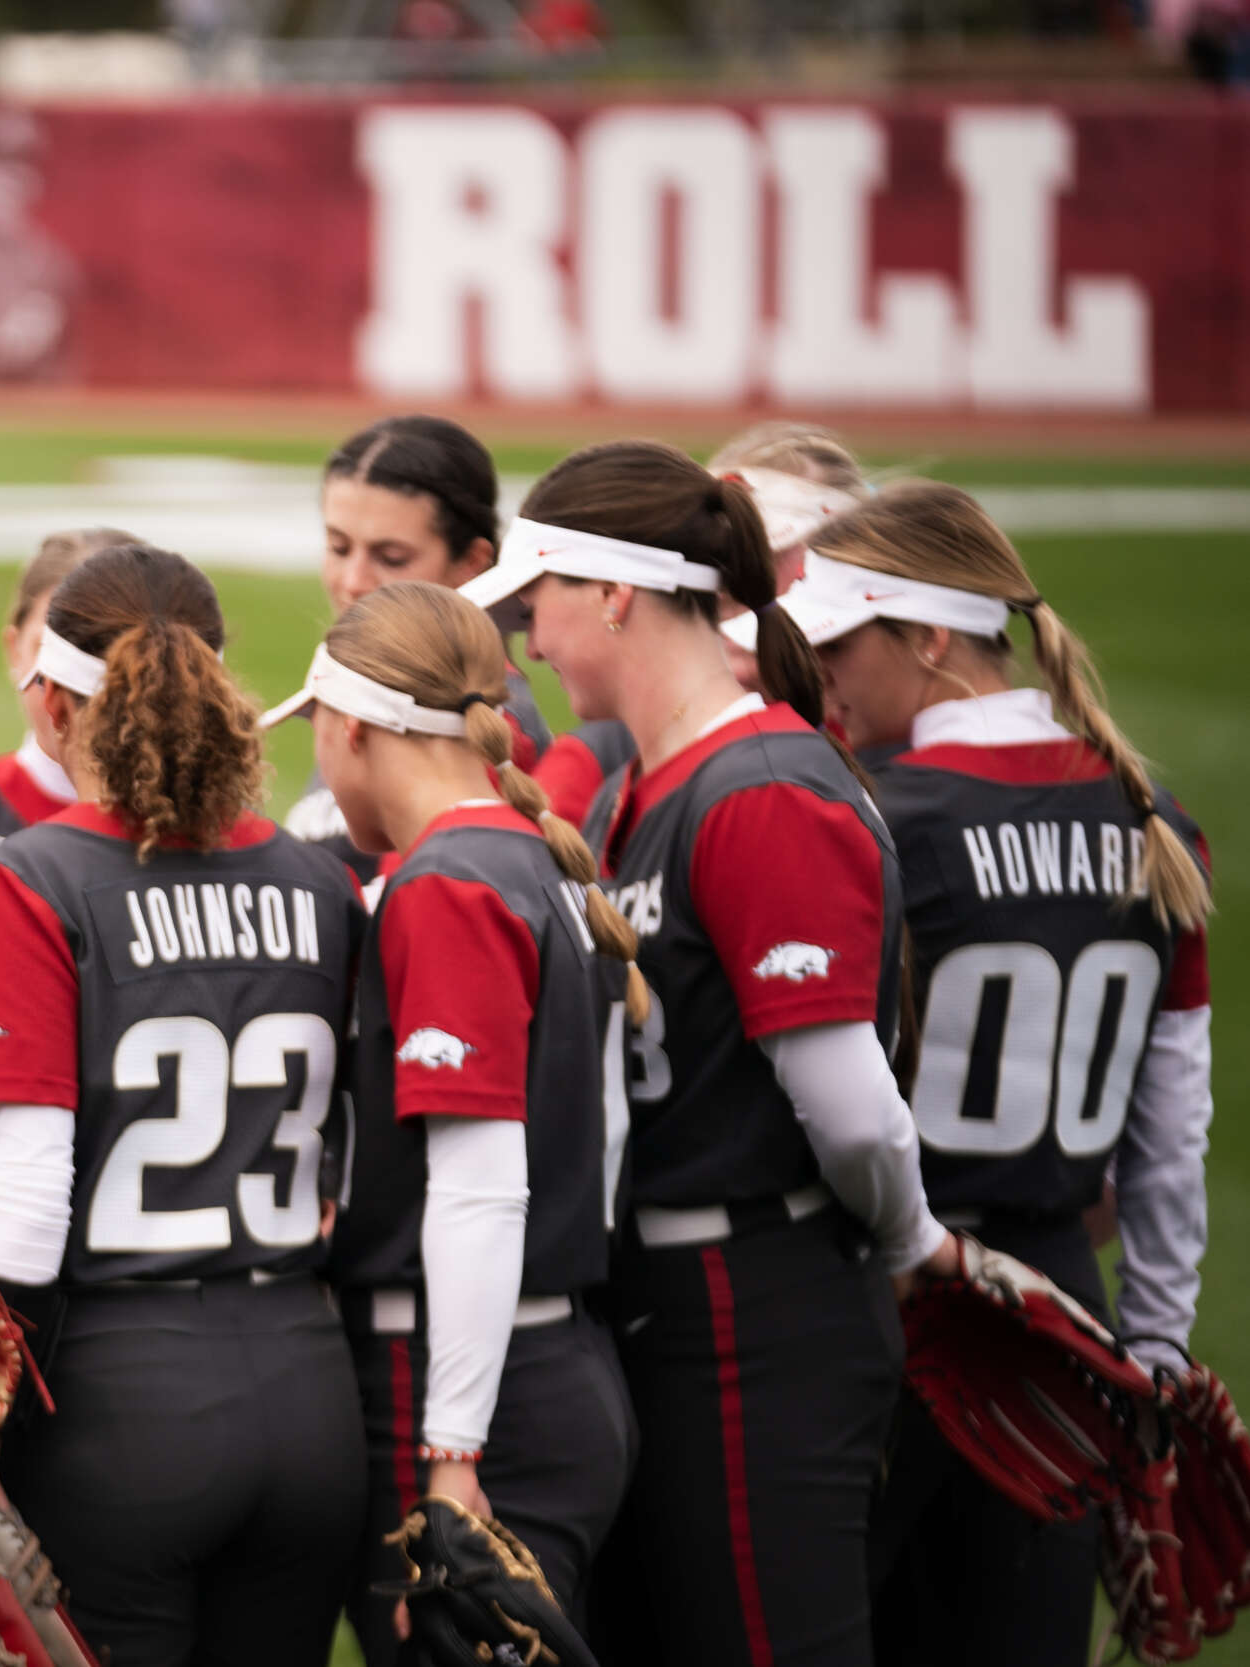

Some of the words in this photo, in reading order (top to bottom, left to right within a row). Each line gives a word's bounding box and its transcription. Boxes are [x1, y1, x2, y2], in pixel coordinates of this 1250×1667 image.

[359, 106, 1149, 406] ROLL
[126, 882, 320, 968] JOHNSON
[87, 1011, 338, 1252] 23
[910, 939, 1162, 1160] 00
